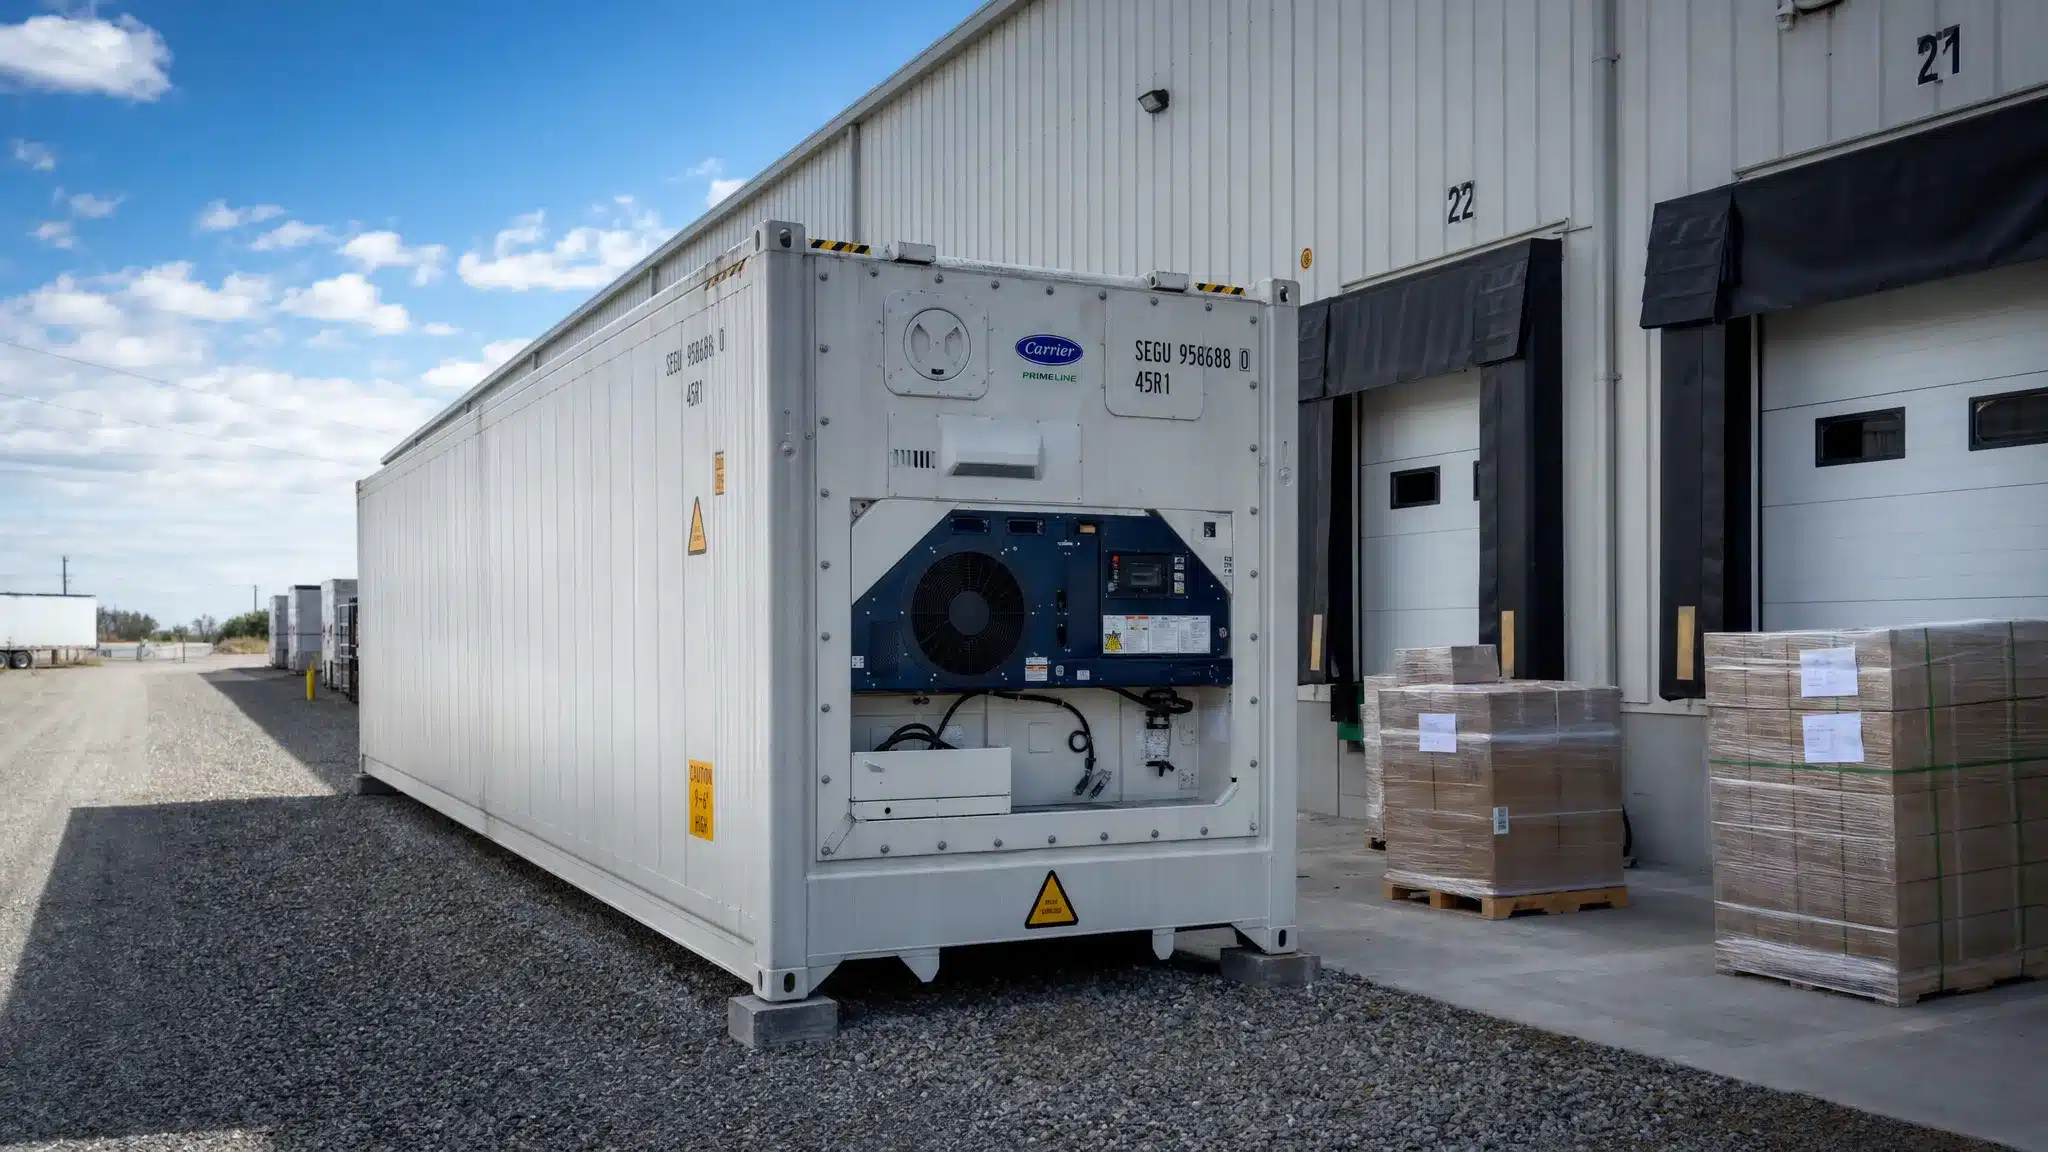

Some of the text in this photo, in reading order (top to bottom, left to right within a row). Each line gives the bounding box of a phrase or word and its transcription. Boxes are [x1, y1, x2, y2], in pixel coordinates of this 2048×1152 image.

[1917, 24, 1960, 86] 21
[1448, 181, 1474, 224] 22
[1025, 341, 1075, 357] Carrier
[1135, 340, 1171, 363] SEGU
[1180, 344, 1231, 369] 958688
[1022, 371, 1077, 383] PRIMELINE
[1135, 371, 1170, 395] 45R1
[687, 379, 703, 408] 45R1
